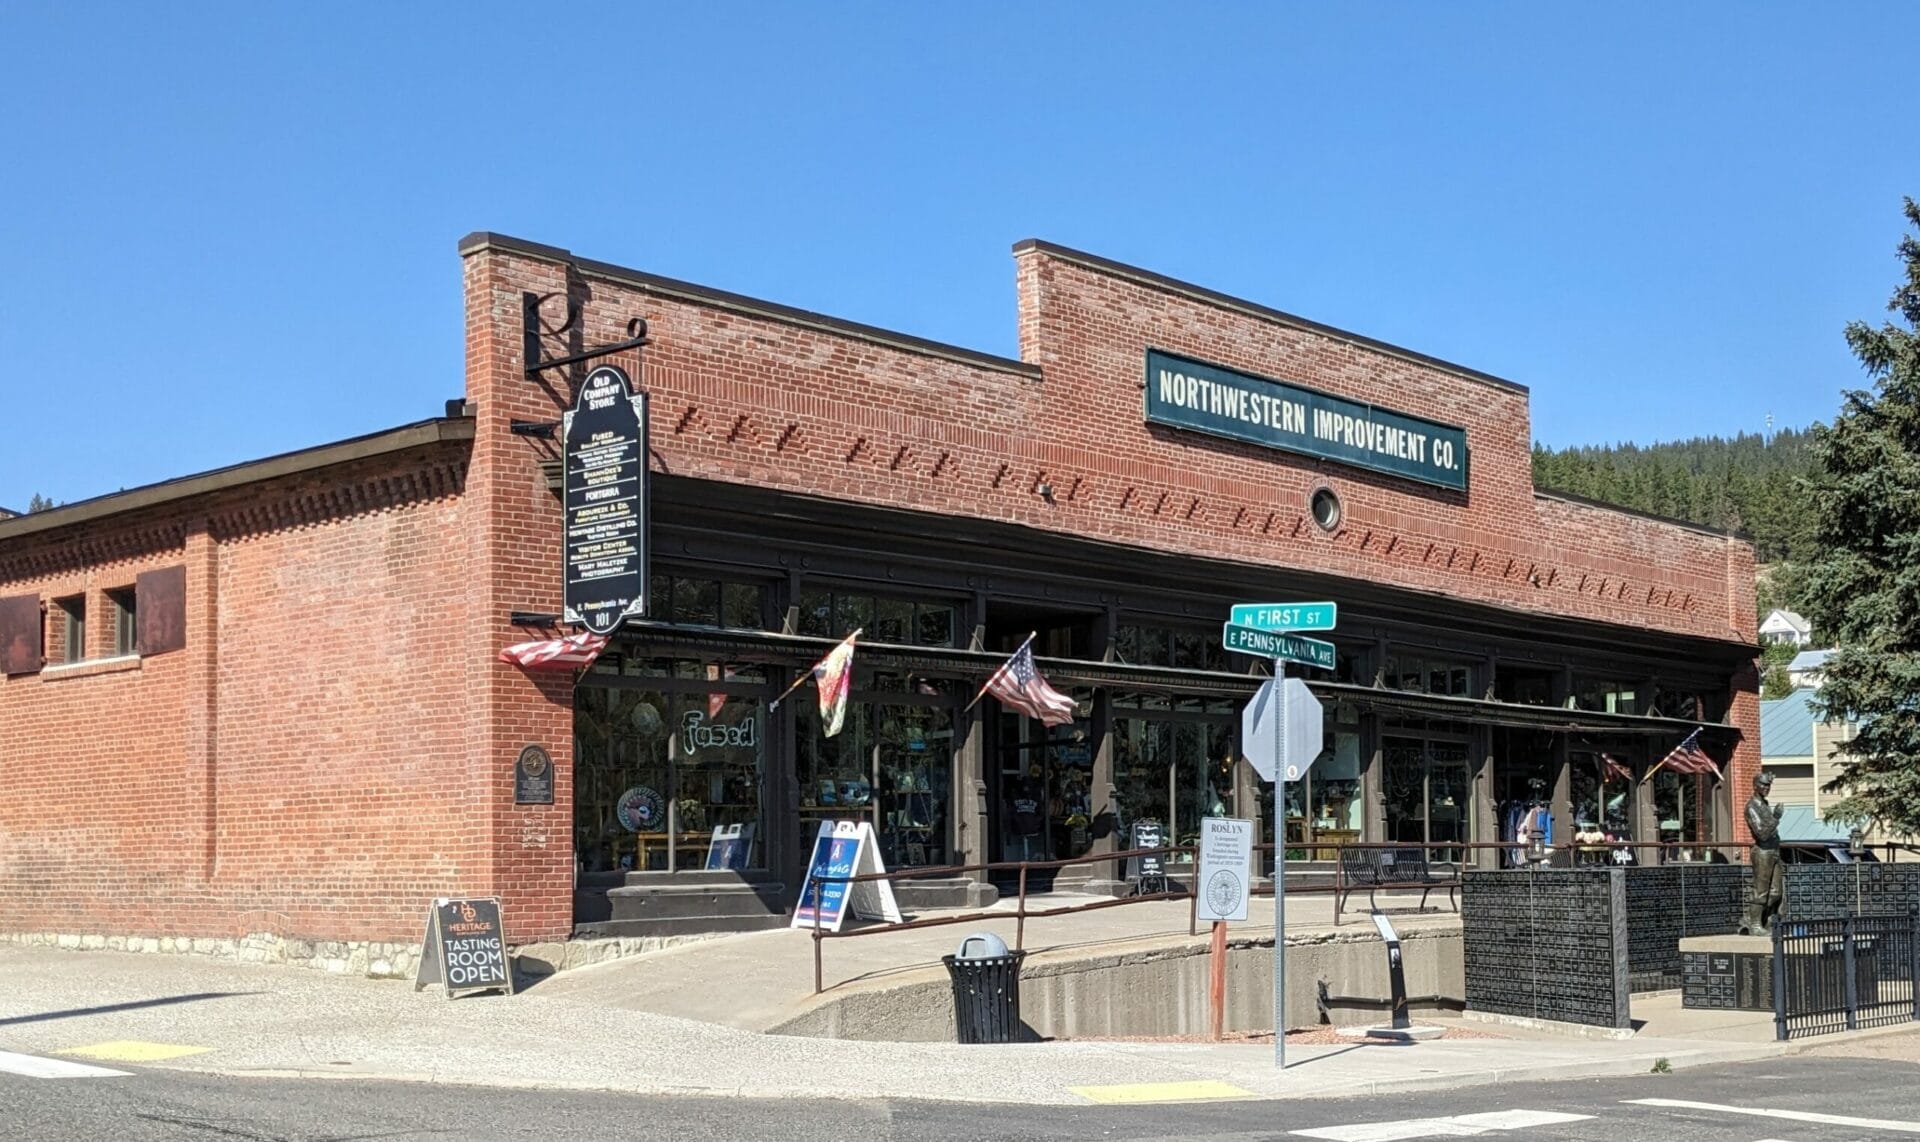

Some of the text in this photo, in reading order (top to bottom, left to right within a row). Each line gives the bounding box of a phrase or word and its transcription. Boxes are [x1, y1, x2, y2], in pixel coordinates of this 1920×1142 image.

[593, 376, 610, 388] OLD
[584, 384, 620, 400] COMPANY
[589, 396, 616, 410] STORE
[1160, 370, 1459, 470] NORTHWESTERN IMPROVEMENT CO.
[602, 540, 627, 550] CENTER
[595, 612, 609, 627] 101
[1244, 609, 1321, 626] N FIRST ST
[1230, 630, 1332, 664] E PENNSYLVANIA AVE
[1211, 823, 1243, 834] ROSLYN
[448, 922, 492, 932] HERITAGE
[444, 938, 500, 951] TASTING
[447, 950, 503, 967] ROOM
[450, 965, 505, 984] OPEN
